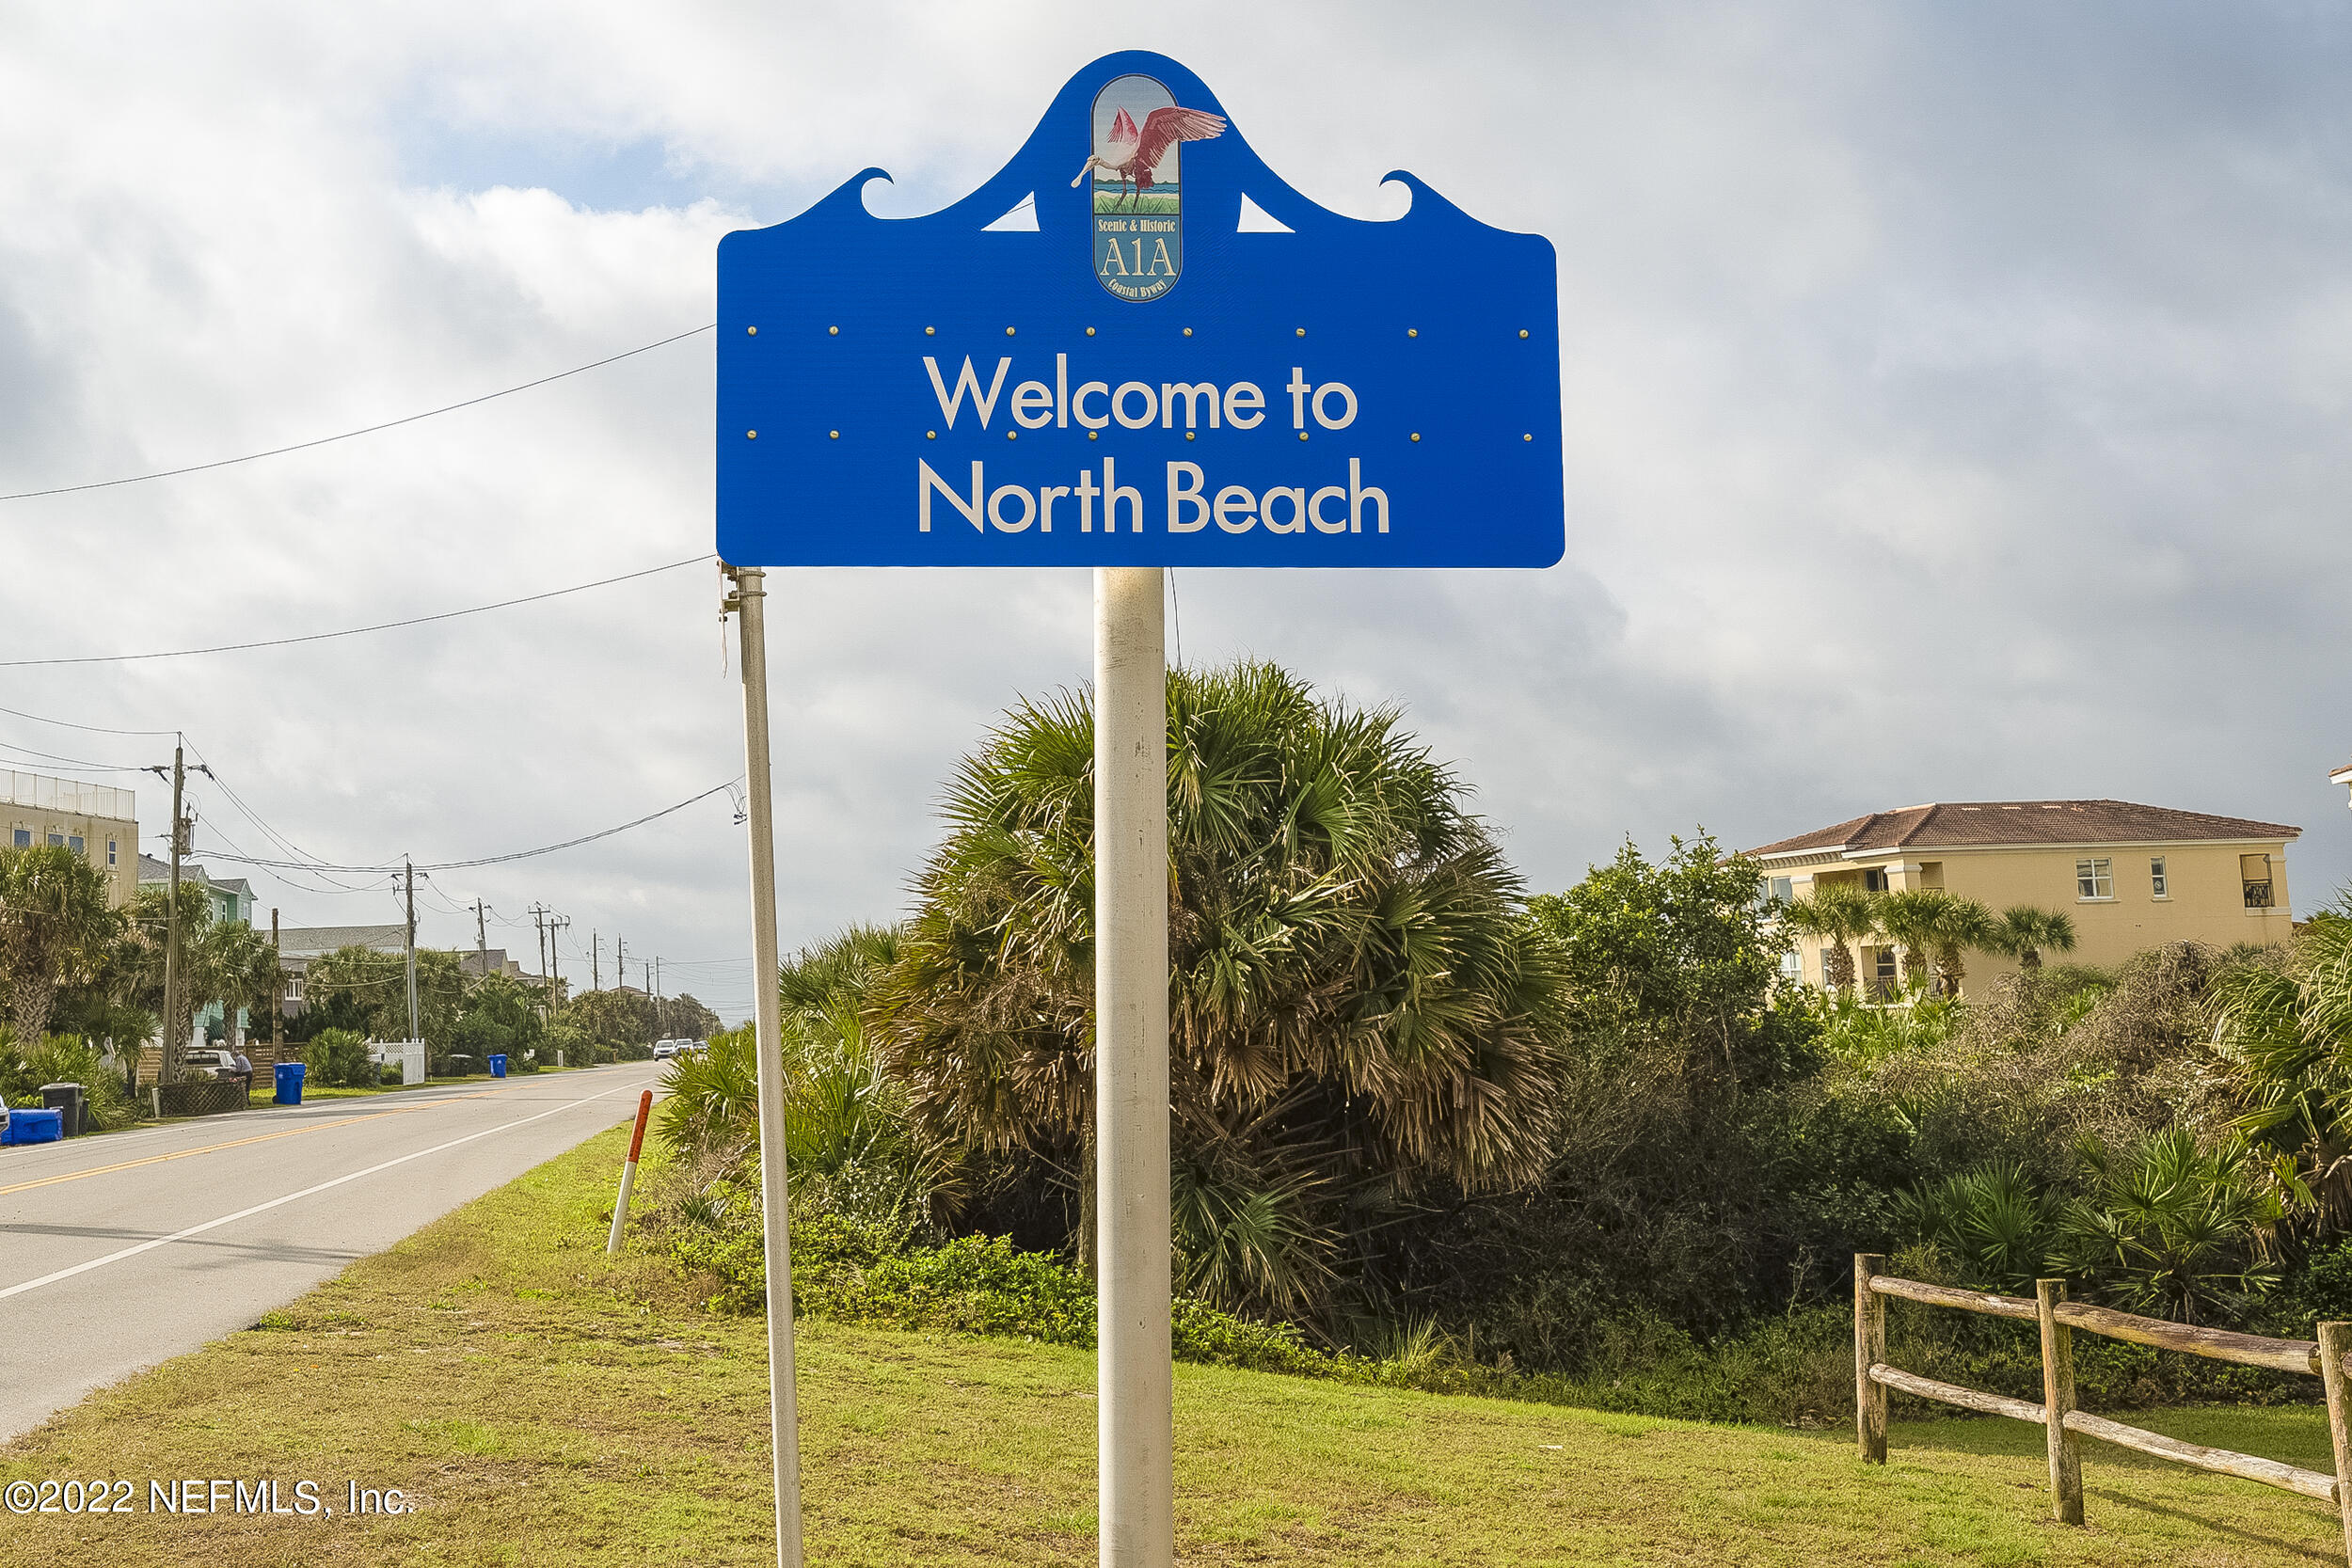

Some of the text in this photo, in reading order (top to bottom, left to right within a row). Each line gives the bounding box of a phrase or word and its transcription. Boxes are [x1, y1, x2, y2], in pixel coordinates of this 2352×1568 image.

[1098, 219, 1175, 232] Scenic & Historic
[1100, 237, 1176, 276] A1A
[1108, 278, 1167, 297] Coastal Byway
[922, 353, 1359, 431] Welcome to
[918, 456, 1390, 534] North Beach
